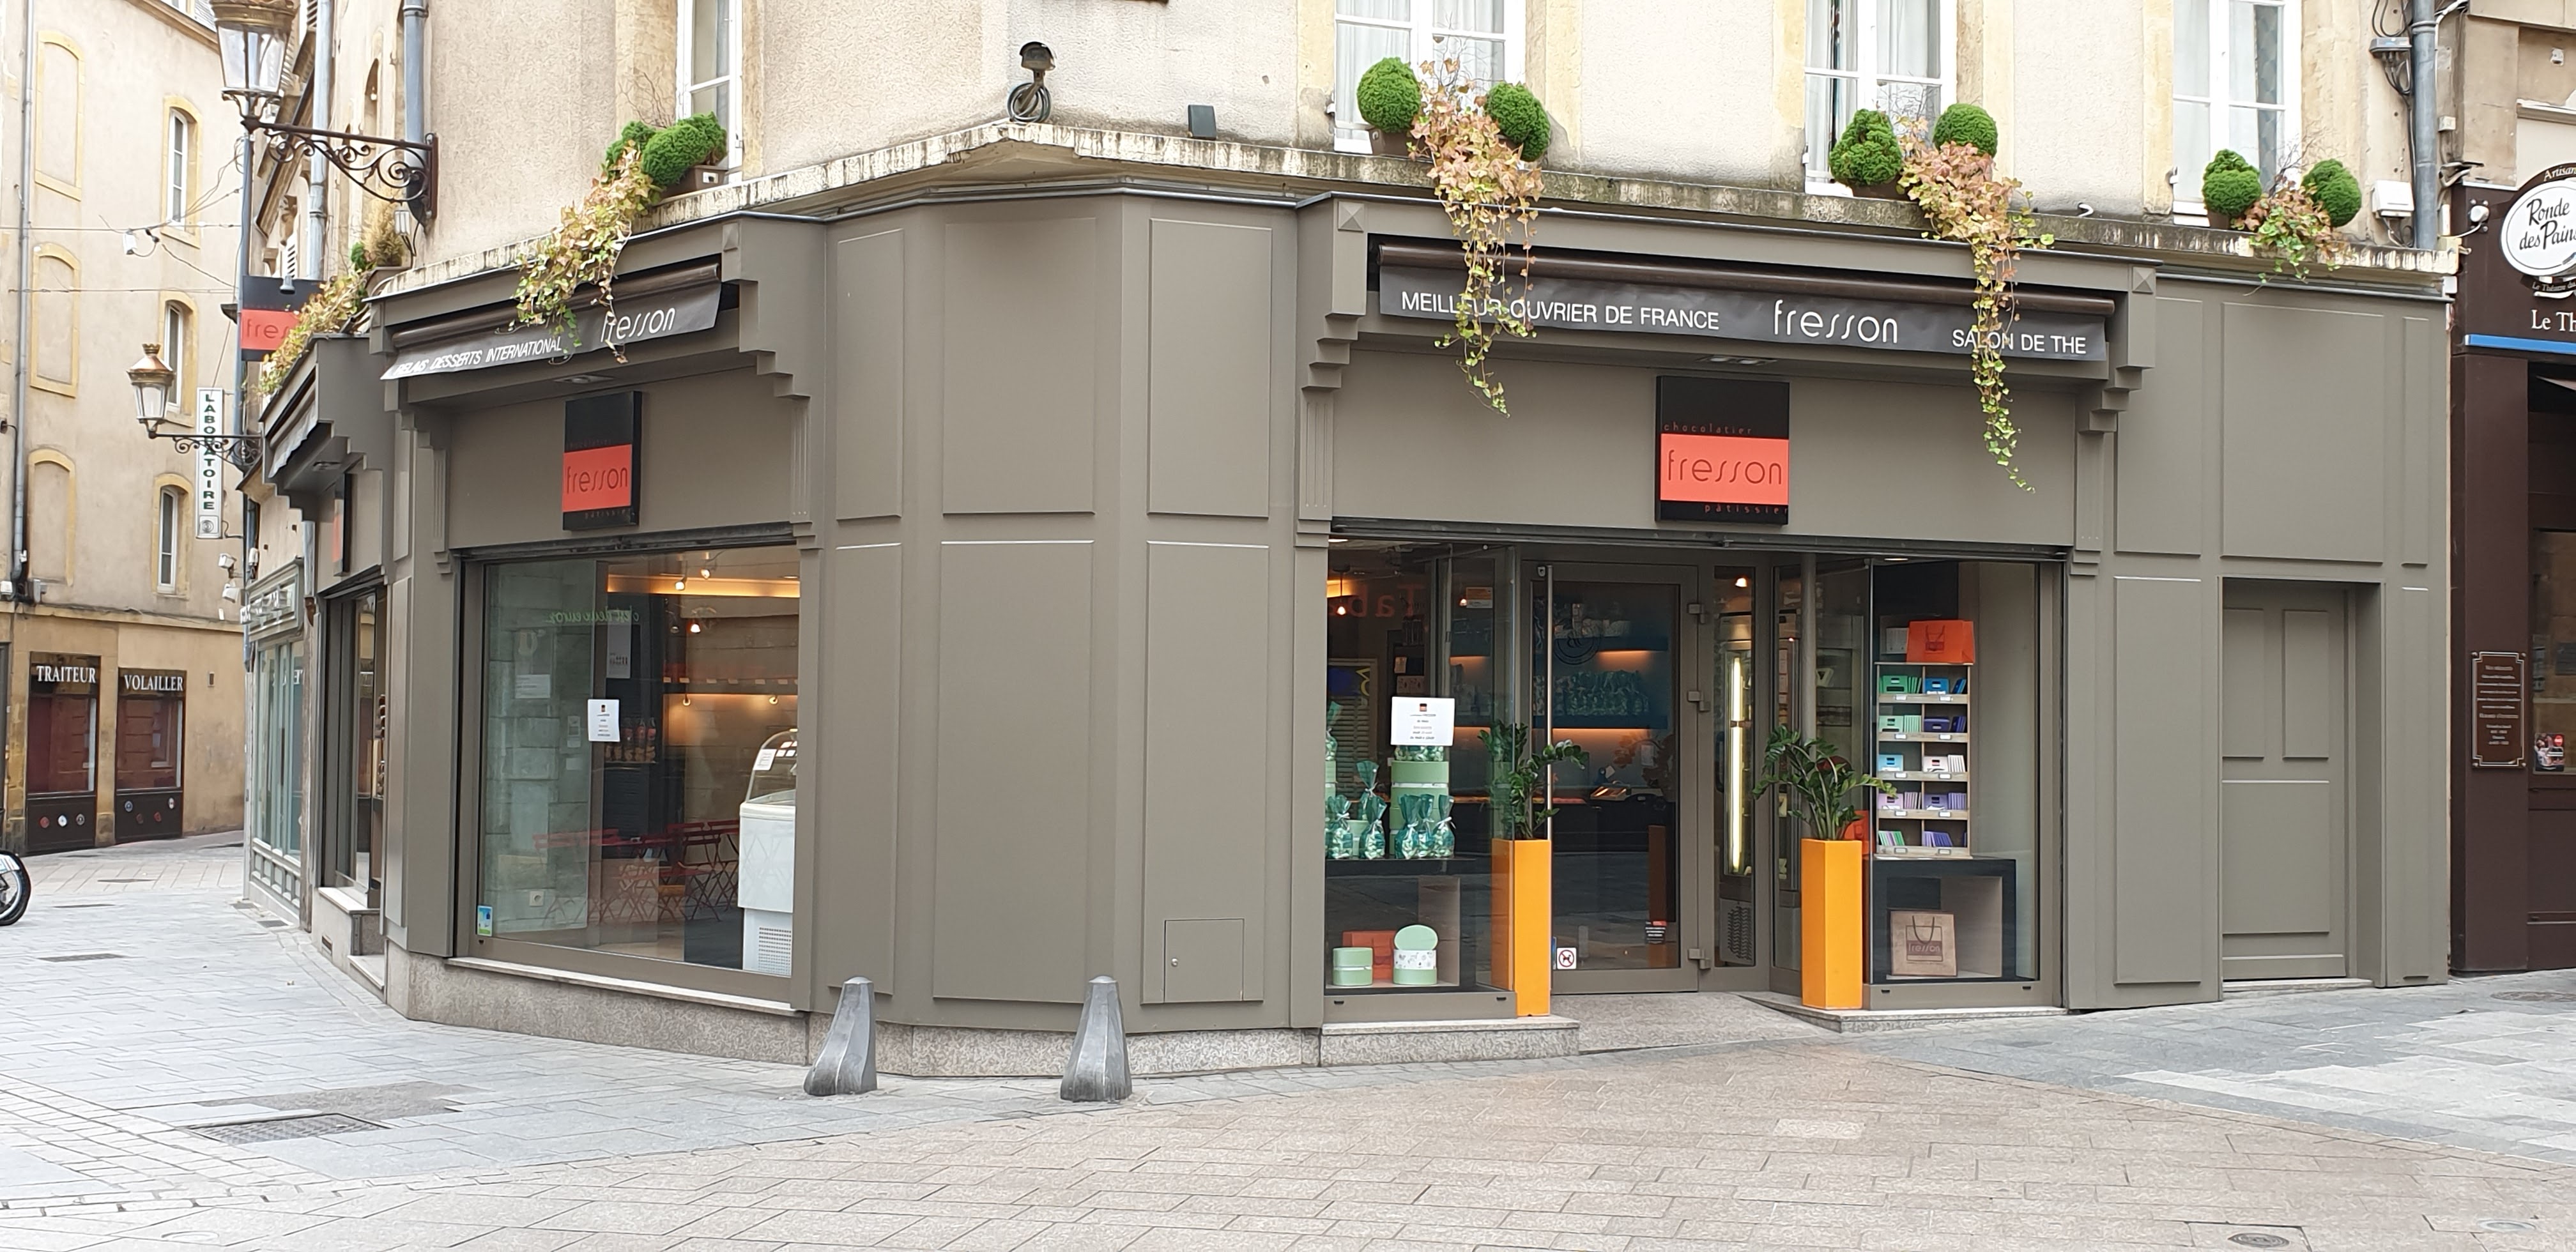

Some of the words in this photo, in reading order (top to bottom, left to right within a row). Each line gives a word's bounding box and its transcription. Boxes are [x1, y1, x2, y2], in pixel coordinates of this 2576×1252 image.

[2526, 197, 2571, 226] Ronde
[2519, 231, 2541, 250] des
[1402, 291, 1502, 317] MEILLEUR
[1510, 299, 1597, 323] OUVRIER
[1605, 305, 1633, 324] DE
[1640, 307, 1720, 330] FRANCE
[1774, 299, 1898, 344] fresson
[2531, 309, 2551, 330] Le
[247, 318, 289, 340] fres
[1952, 329, 2014, 350] SALON
[2021, 334, 2045, 352] DE
[2050, 335, 2087, 354] THE
[395, 358, 430, 376] RELAIS
[429, 349, 483, 370] DESSERTS
[486, 336, 563, 363] INTERNATIONAL
[1664, 421, 1752, 434] chocolatier
[1668, 449, 1782, 485] fresson
[567, 466, 628, 494] fresson
[36, 666, 96, 683] TRAITEUR
[124, 675, 184, 692] VOLAILLER
